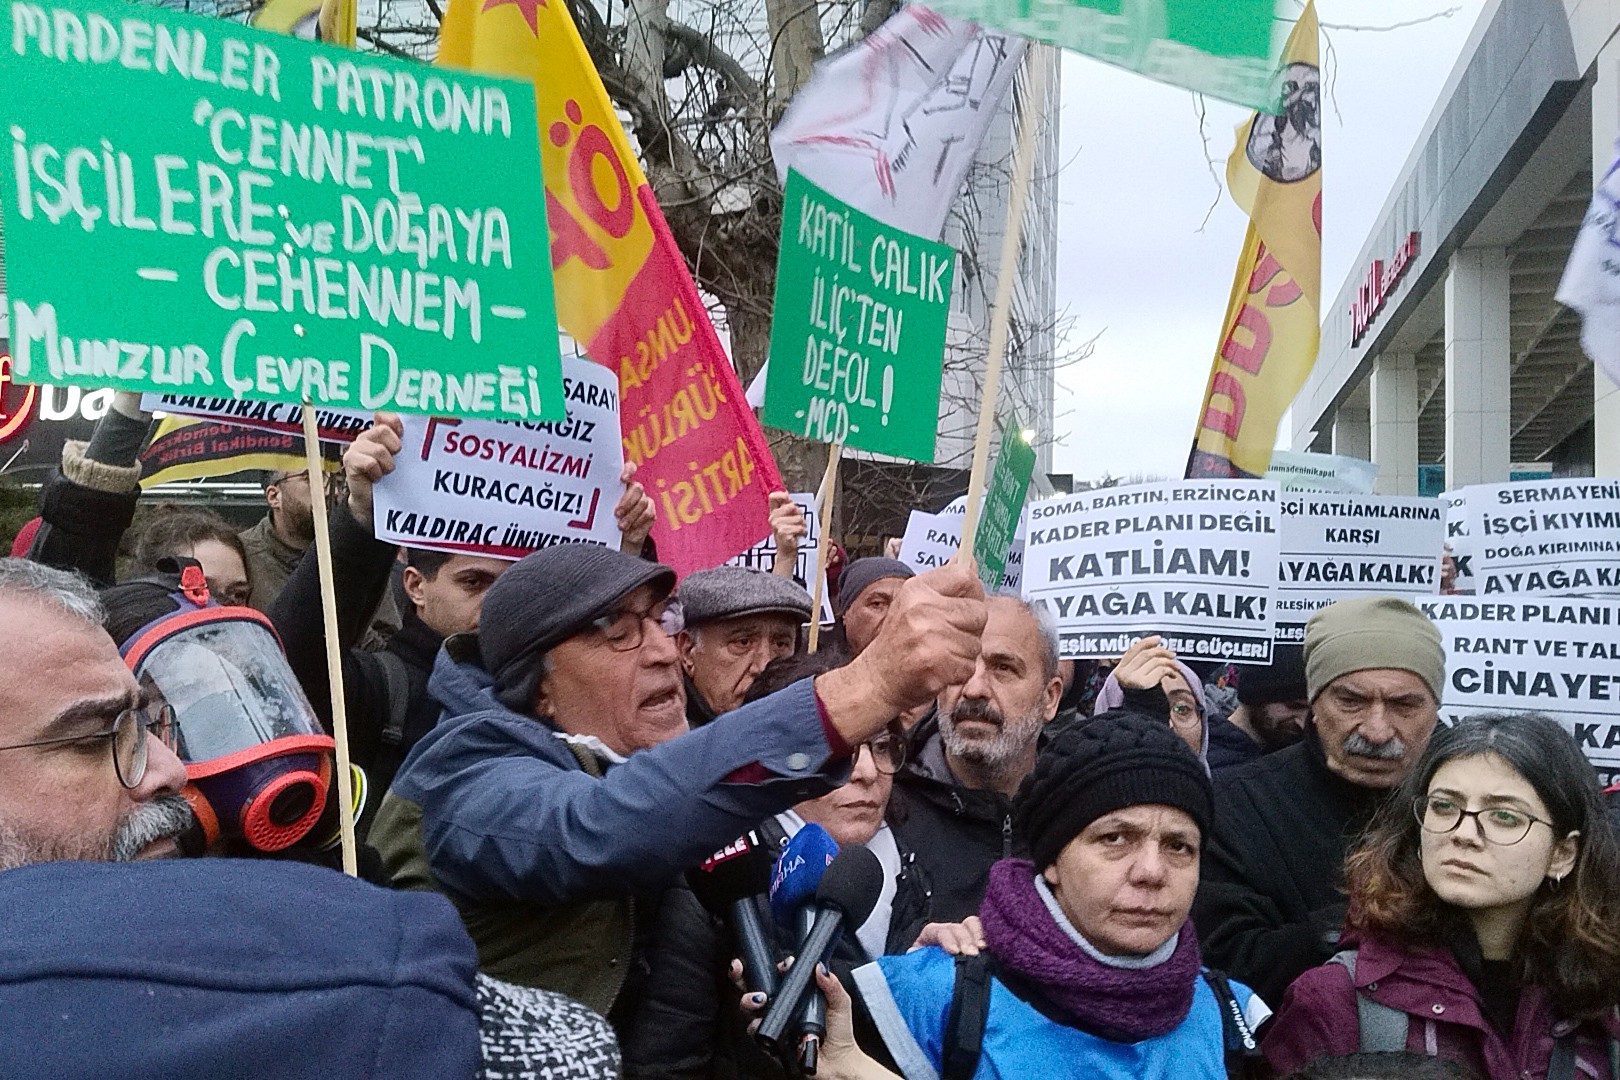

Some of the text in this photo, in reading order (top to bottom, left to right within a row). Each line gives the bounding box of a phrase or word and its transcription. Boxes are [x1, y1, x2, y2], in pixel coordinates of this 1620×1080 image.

[11, 1, 512, 139] MADENLER PATRONA
[9, 124, 276, 246] İŞÇİLERE
[341, 194, 513, 270] DOĞAYA
[797, 194, 949, 305] KATİL ÇALIK
[202, 246, 483, 344] CEHENNEM
[221, 318, 350, 403] ÇEVRE
[360, 332, 543, 419] DERNEĞİ
[443, 431, 594, 480] SOSYALİZMİ
[433, 469, 584, 515] KURACAĞIZ!
[1032, 501, 1089, 521] SOMA,
[1092, 489, 1169, 511] BARTIN,
[1172, 484, 1276, 503] ERZİNCAN
[1309, 499, 1441, 521] KATLİAMLARINA
[1483, 509, 1538, 539] İŞÇİ
[1029, 509, 1276, 546] KADER PLANI DEĞİL
[1325, 528, 1381, 548] KARŞI
[1049, 538, 1251, 582] KATLİAM!
[1539, 541, 1614, 556] KIRIMINA
[1358, 562, 1435, 584] KALK!
[1484, 566, 1592, 595] AYAĞA
[1164, 591, 1267, 621] KALK!
[1420, 603, 1516, 623] KADER
[1522, 604, 1611, 626] PLANI
[1196, 638, 1269, 660] GÜÇLERİ
[1454, 637, 1529, 655] RANT
[1534, 640, 1568, 657] VE
